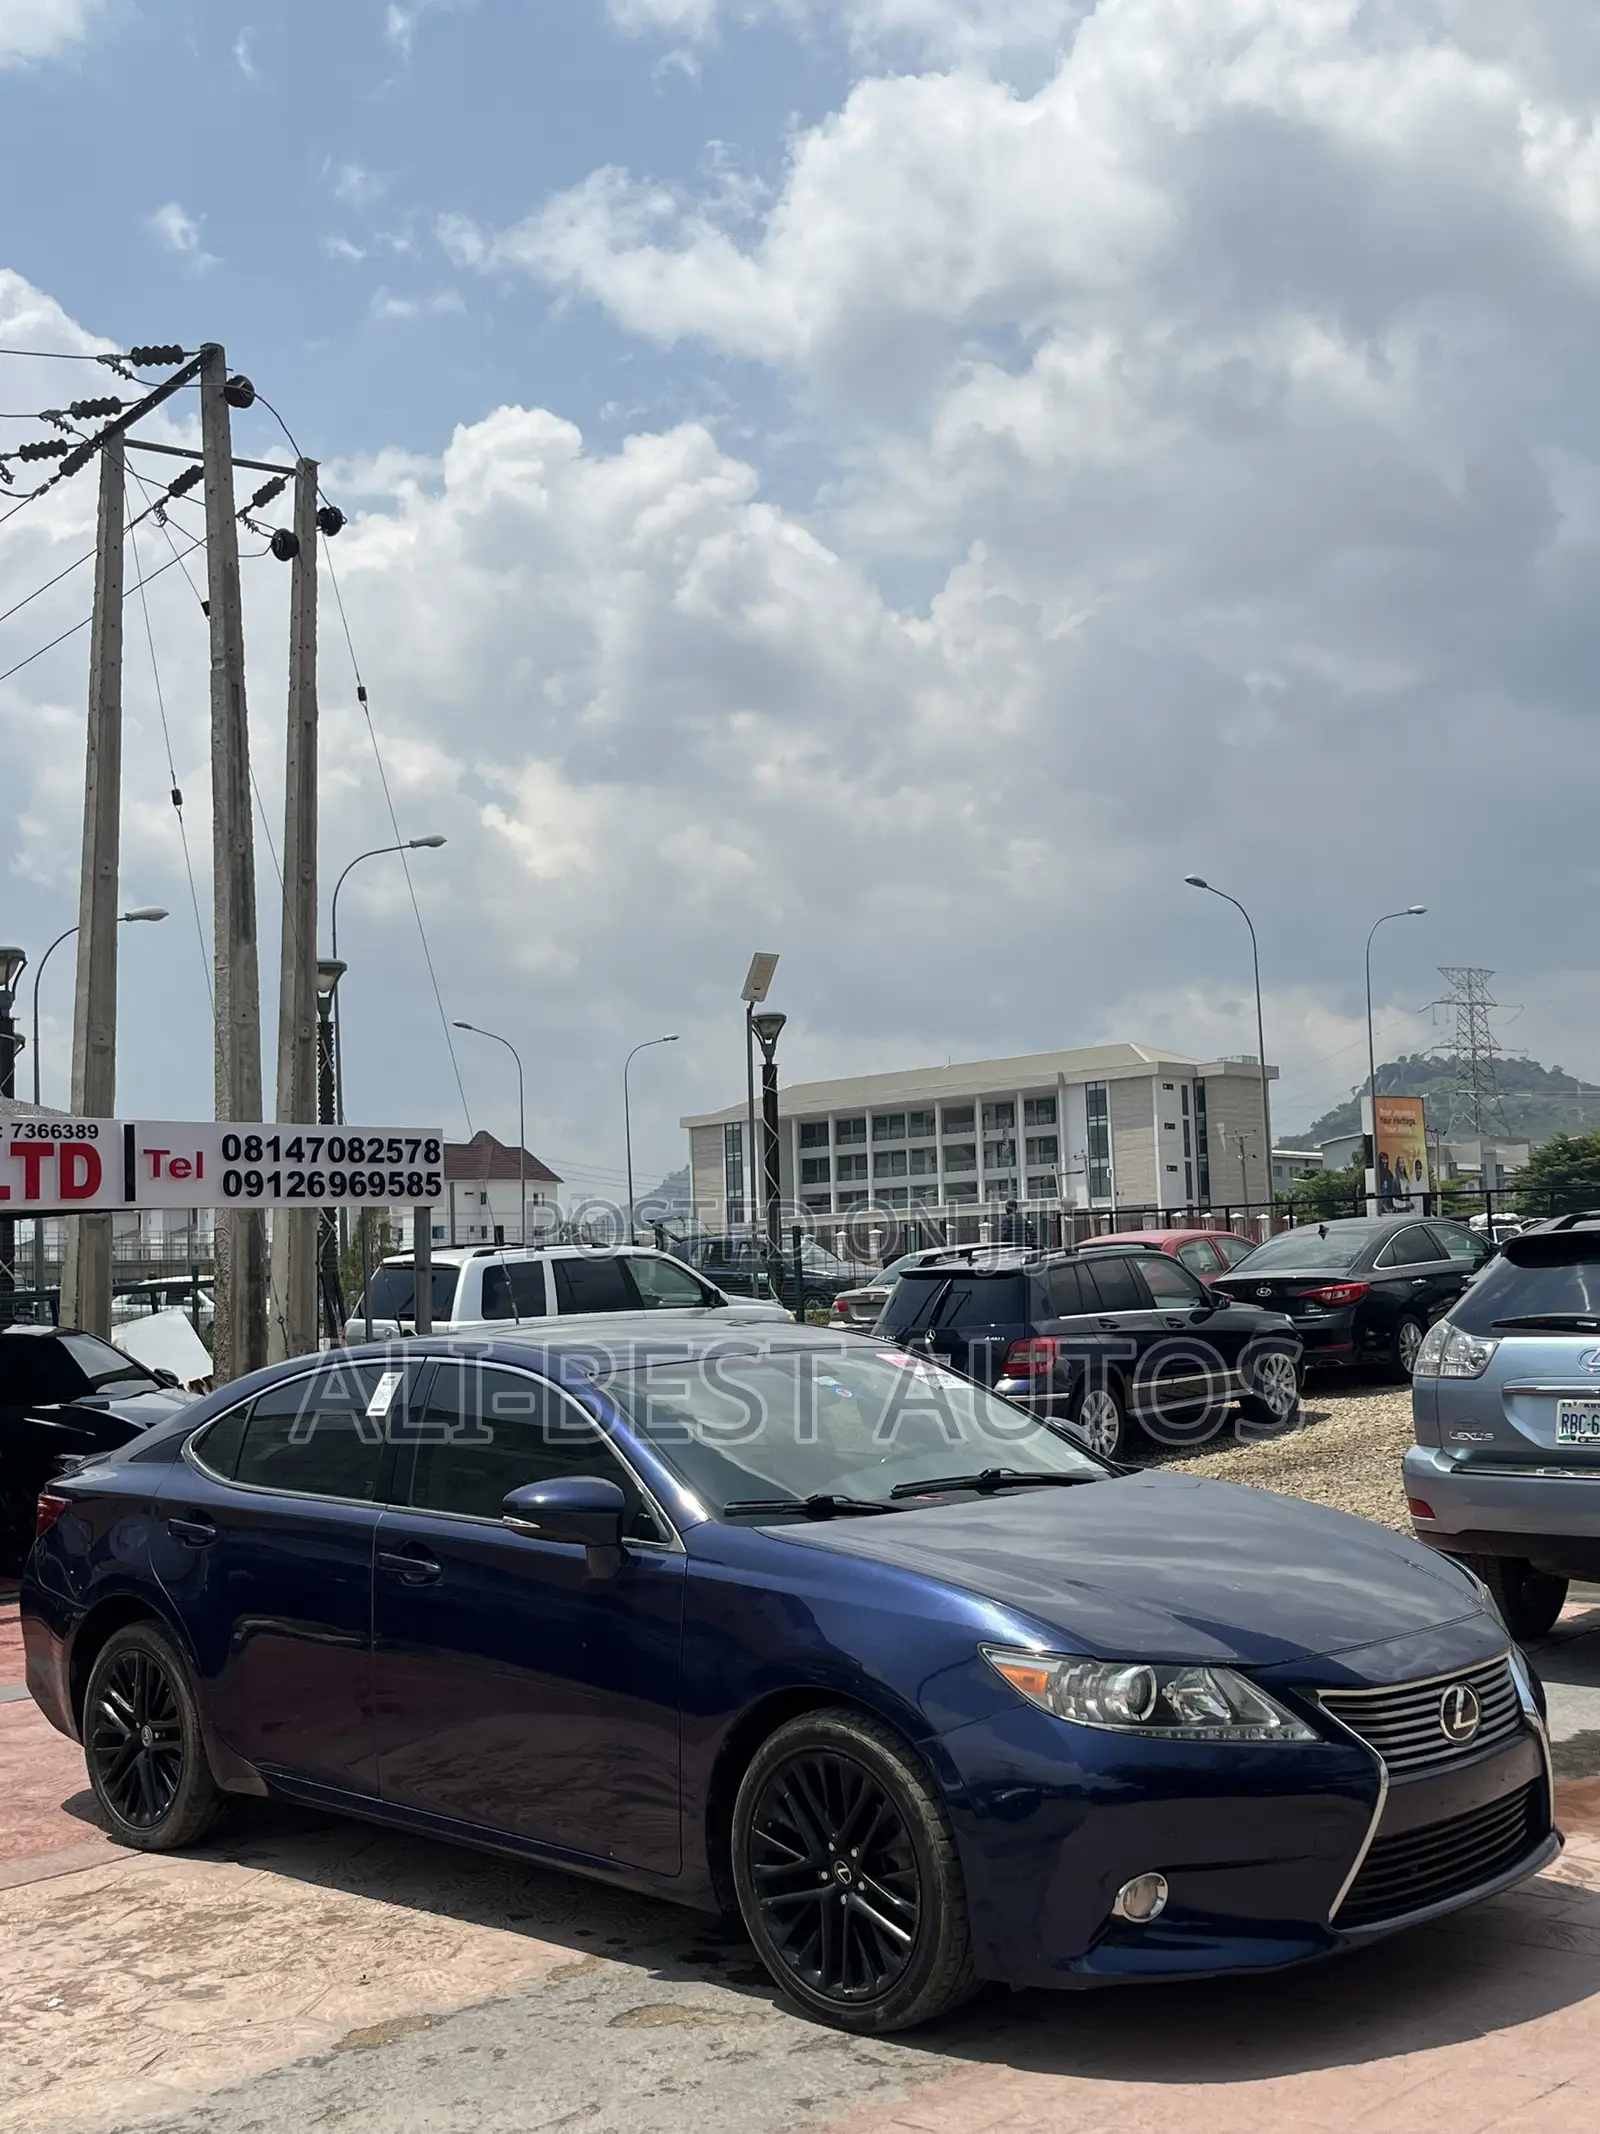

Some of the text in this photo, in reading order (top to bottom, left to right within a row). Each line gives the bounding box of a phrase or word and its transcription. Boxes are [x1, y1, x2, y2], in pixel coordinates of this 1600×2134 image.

[11, 1123, 99, 1140] 7366389
[142, 1148, 204, 1180] Tel
[221, 1133, 442, 1165] 08147082578
[0, 1141, 103, 1200] TD
[222, 1168, 443, 1199] 09126969585
[1448, 1430, 1495, 1442] LEXUS
